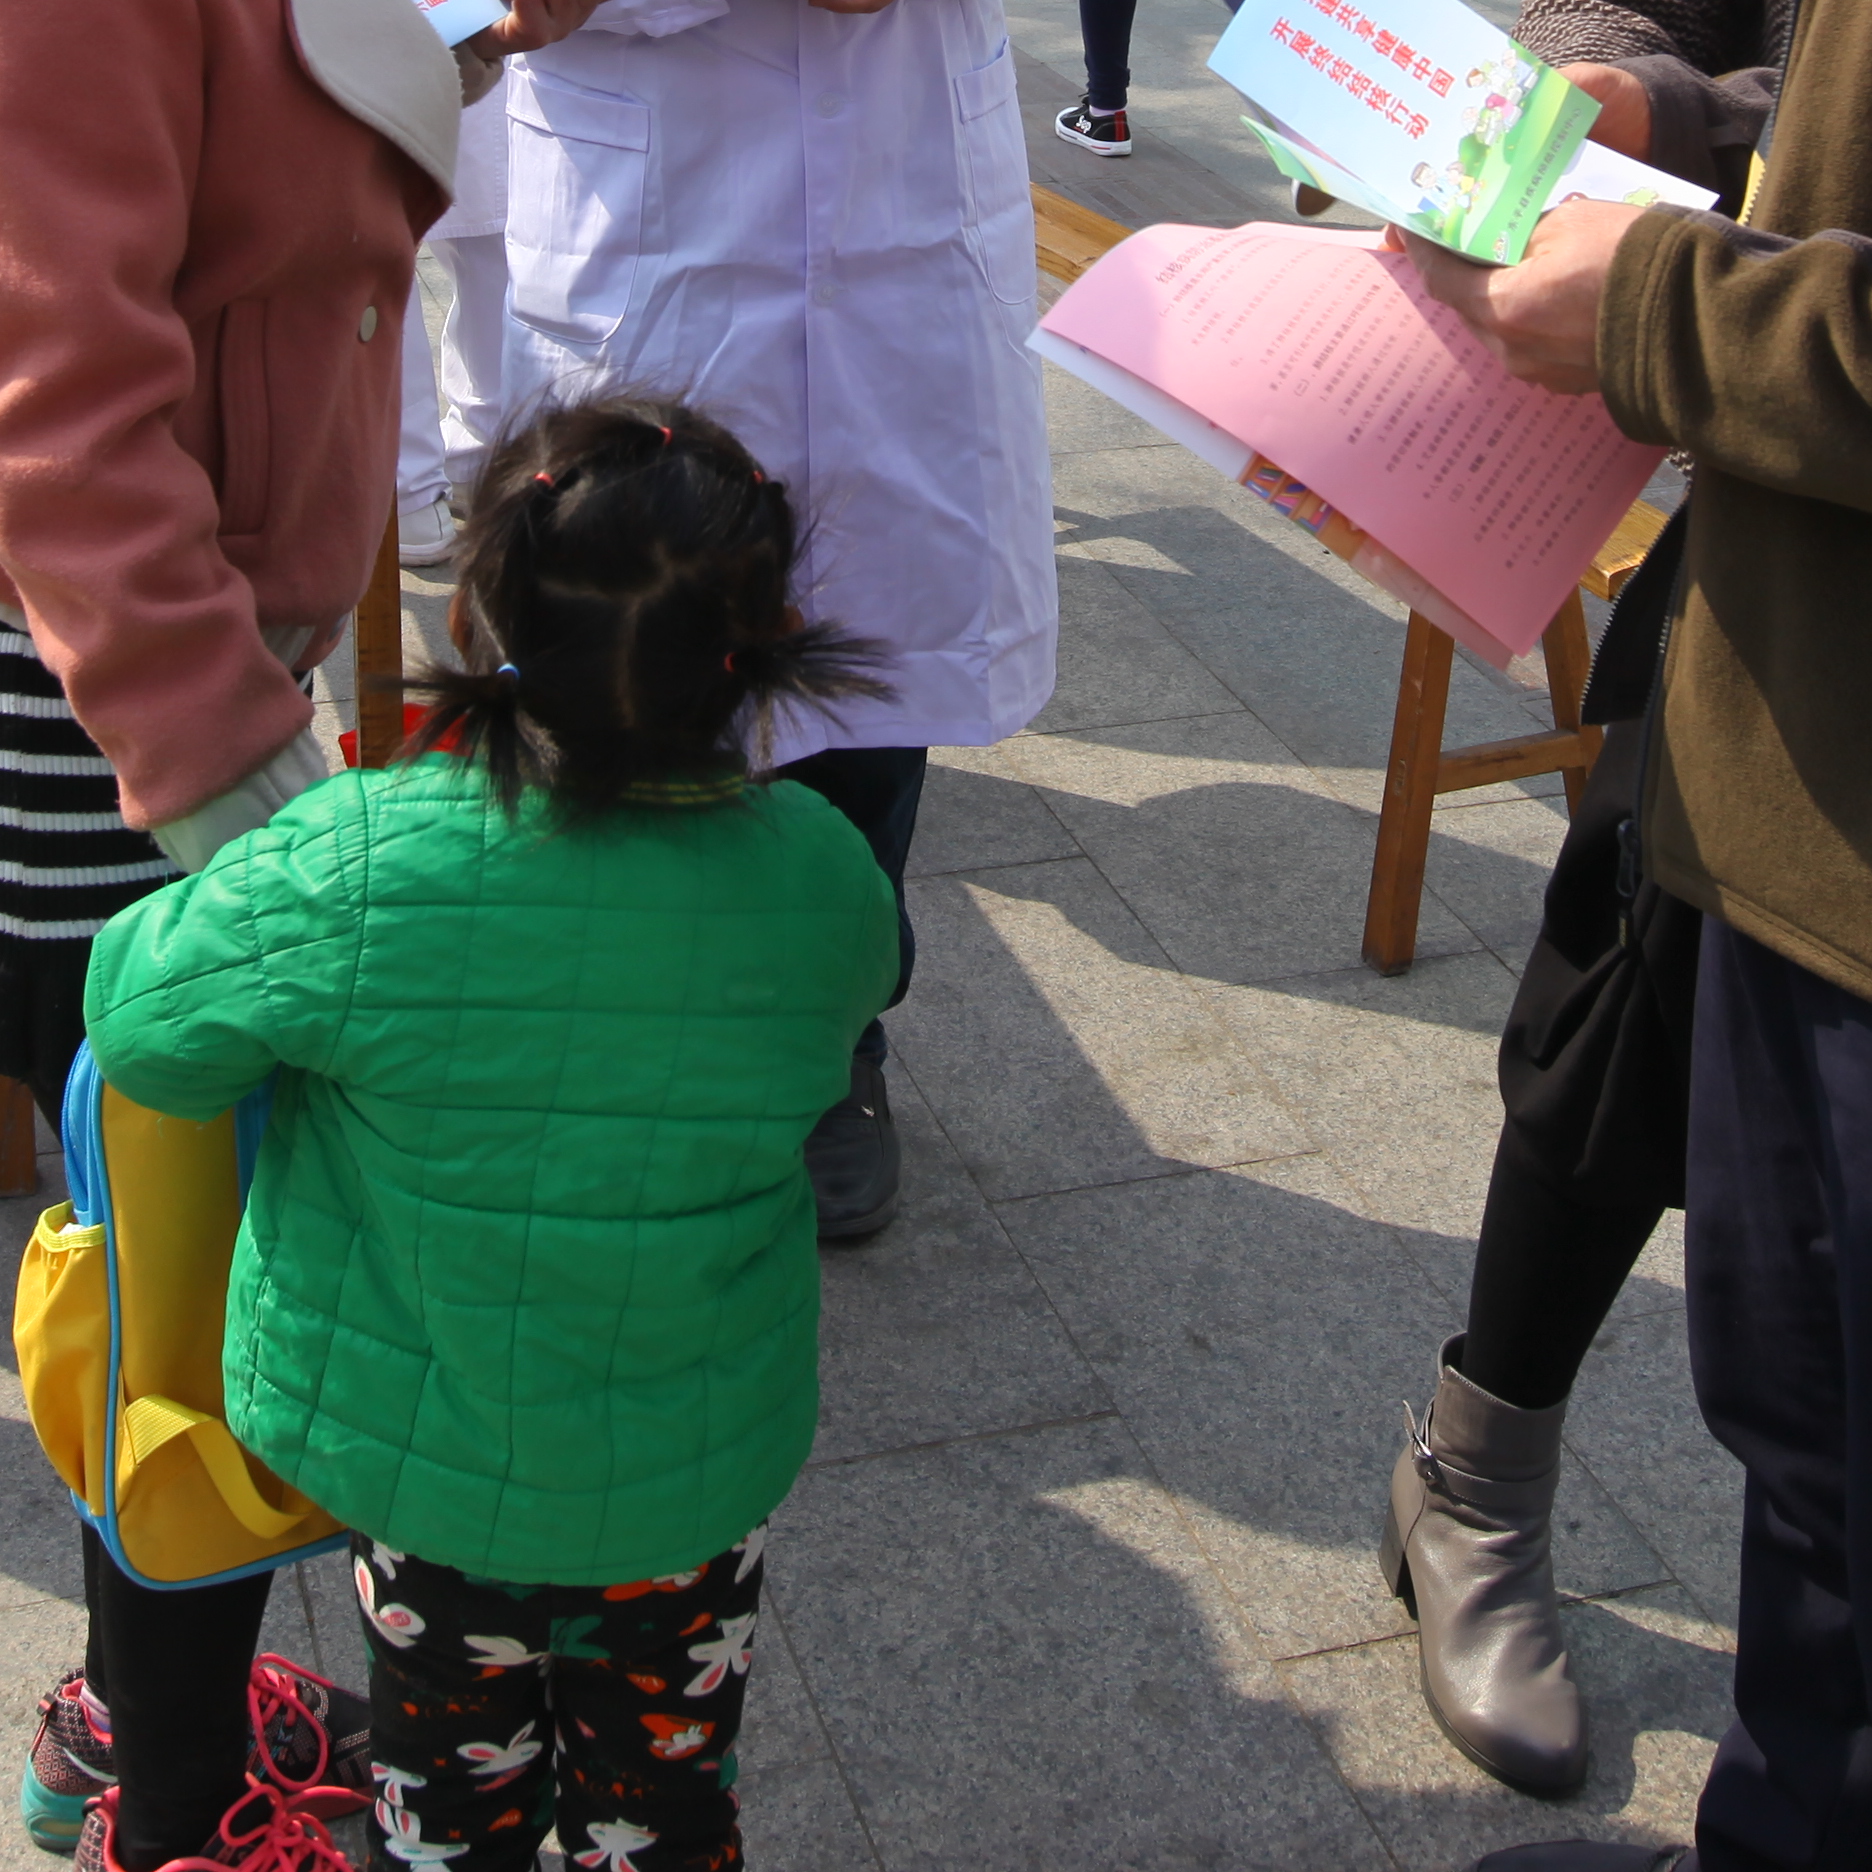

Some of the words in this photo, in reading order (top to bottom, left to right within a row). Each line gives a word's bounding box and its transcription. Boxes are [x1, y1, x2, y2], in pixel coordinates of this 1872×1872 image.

[1268, 15, 1431, 142] 开展终结结核行动
